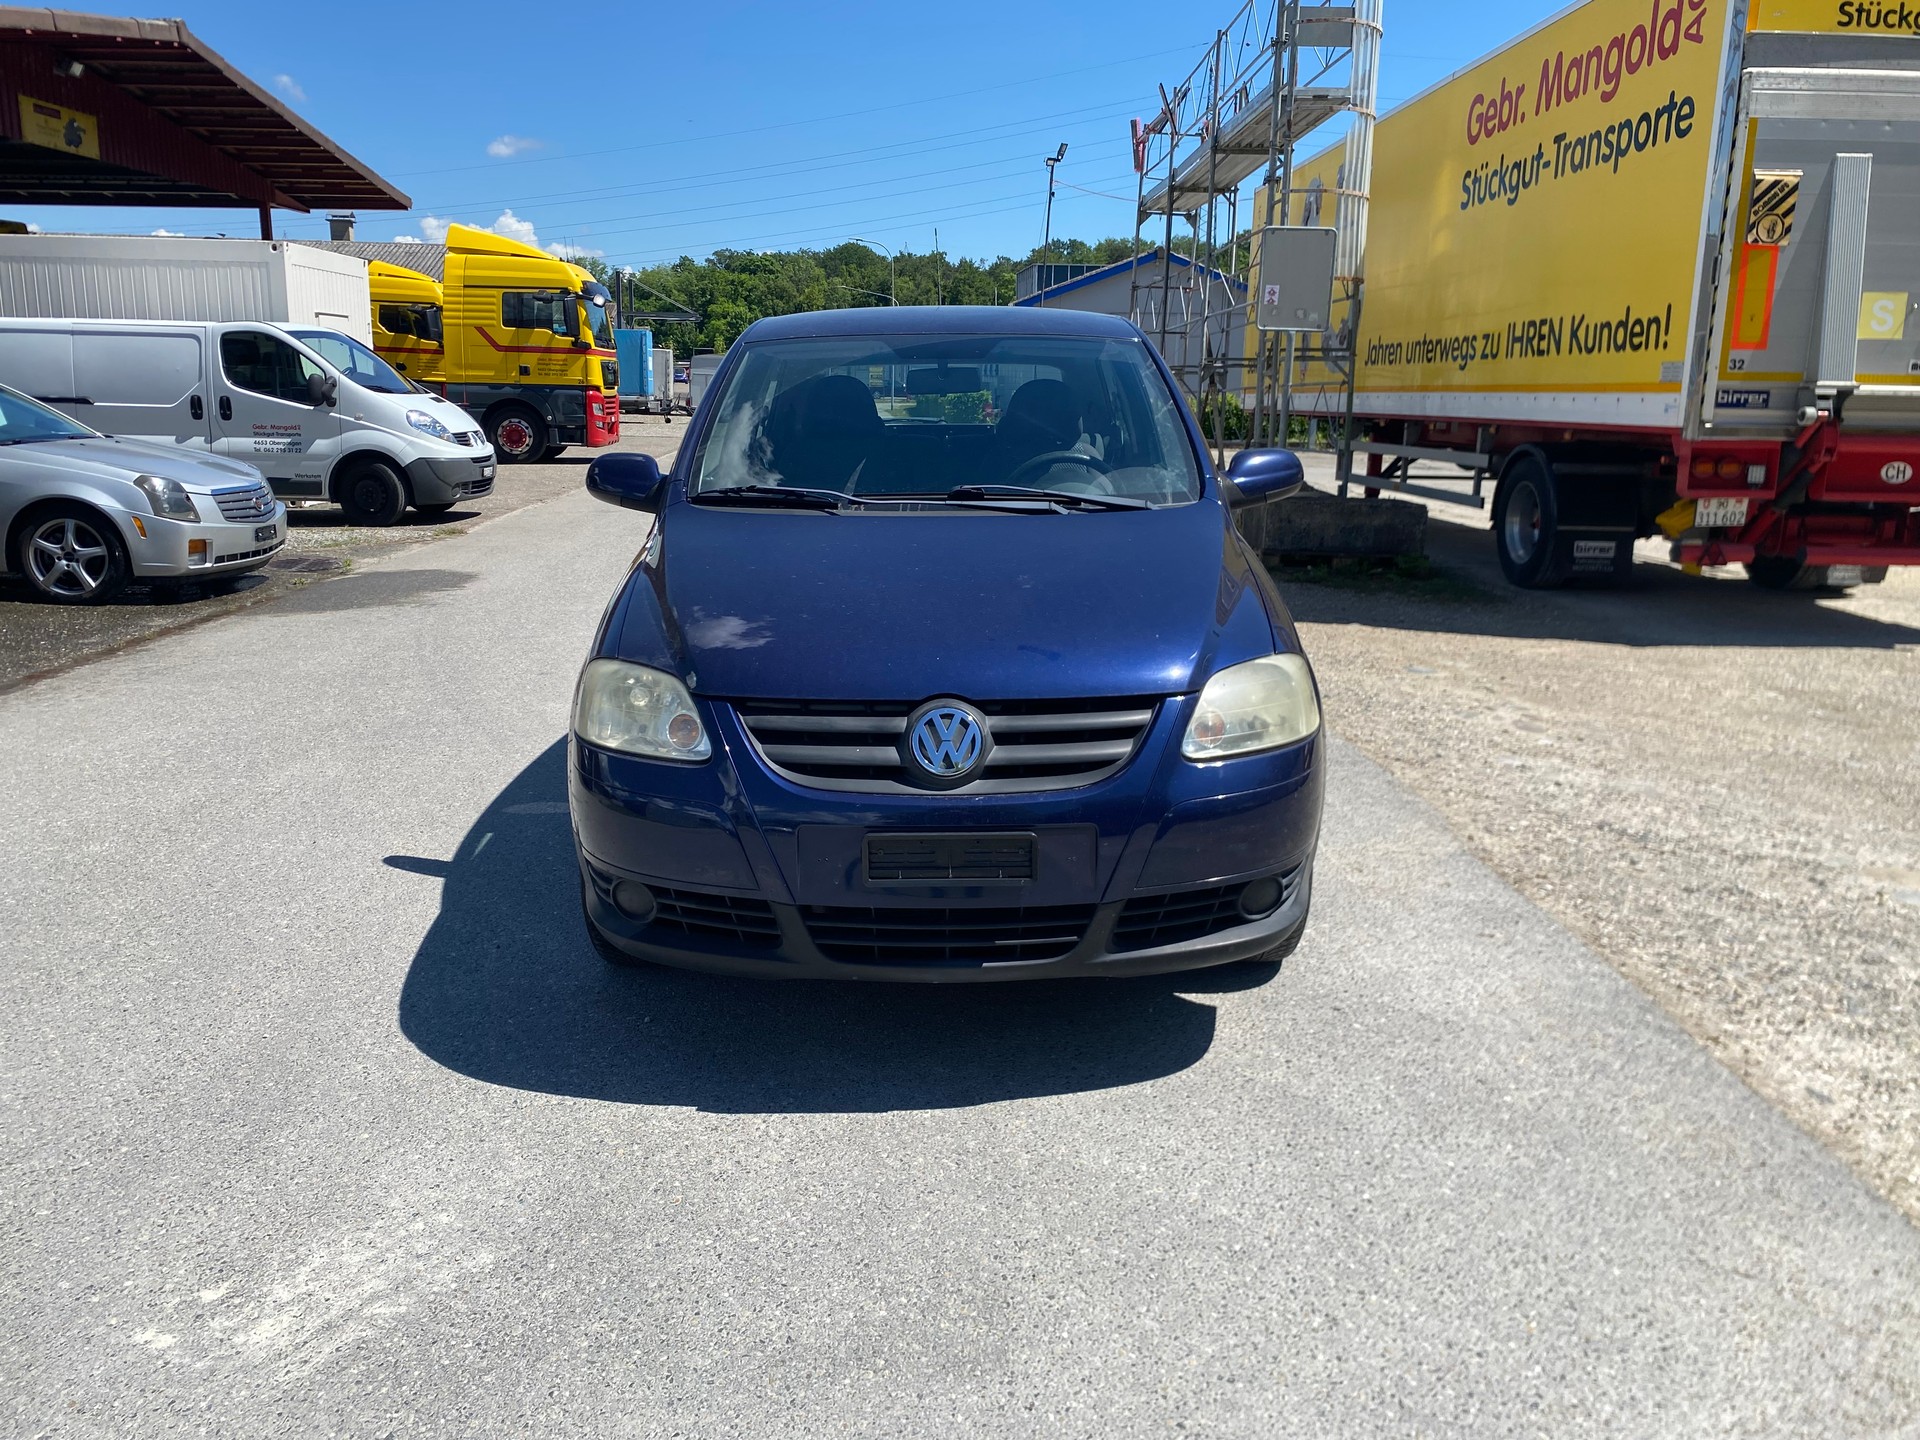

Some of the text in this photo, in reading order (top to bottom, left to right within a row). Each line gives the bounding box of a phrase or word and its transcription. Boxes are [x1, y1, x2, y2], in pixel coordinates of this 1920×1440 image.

[1467, 77, 1525, 145] Gebr.
[1535, 0, 1684, 103] Mangold
[1460, 90, 1695, 210] Stückgut-Transporte
[1870, 300, 1895, 332] S
[1364, 302, 1672, 371] Jahren unterwegs zu IHREN Kunden!
[1729, 359, 1745, 370] 32
[1717, 390, 1768, 404] birrer
[1885, 464, 1907, 480] CH
